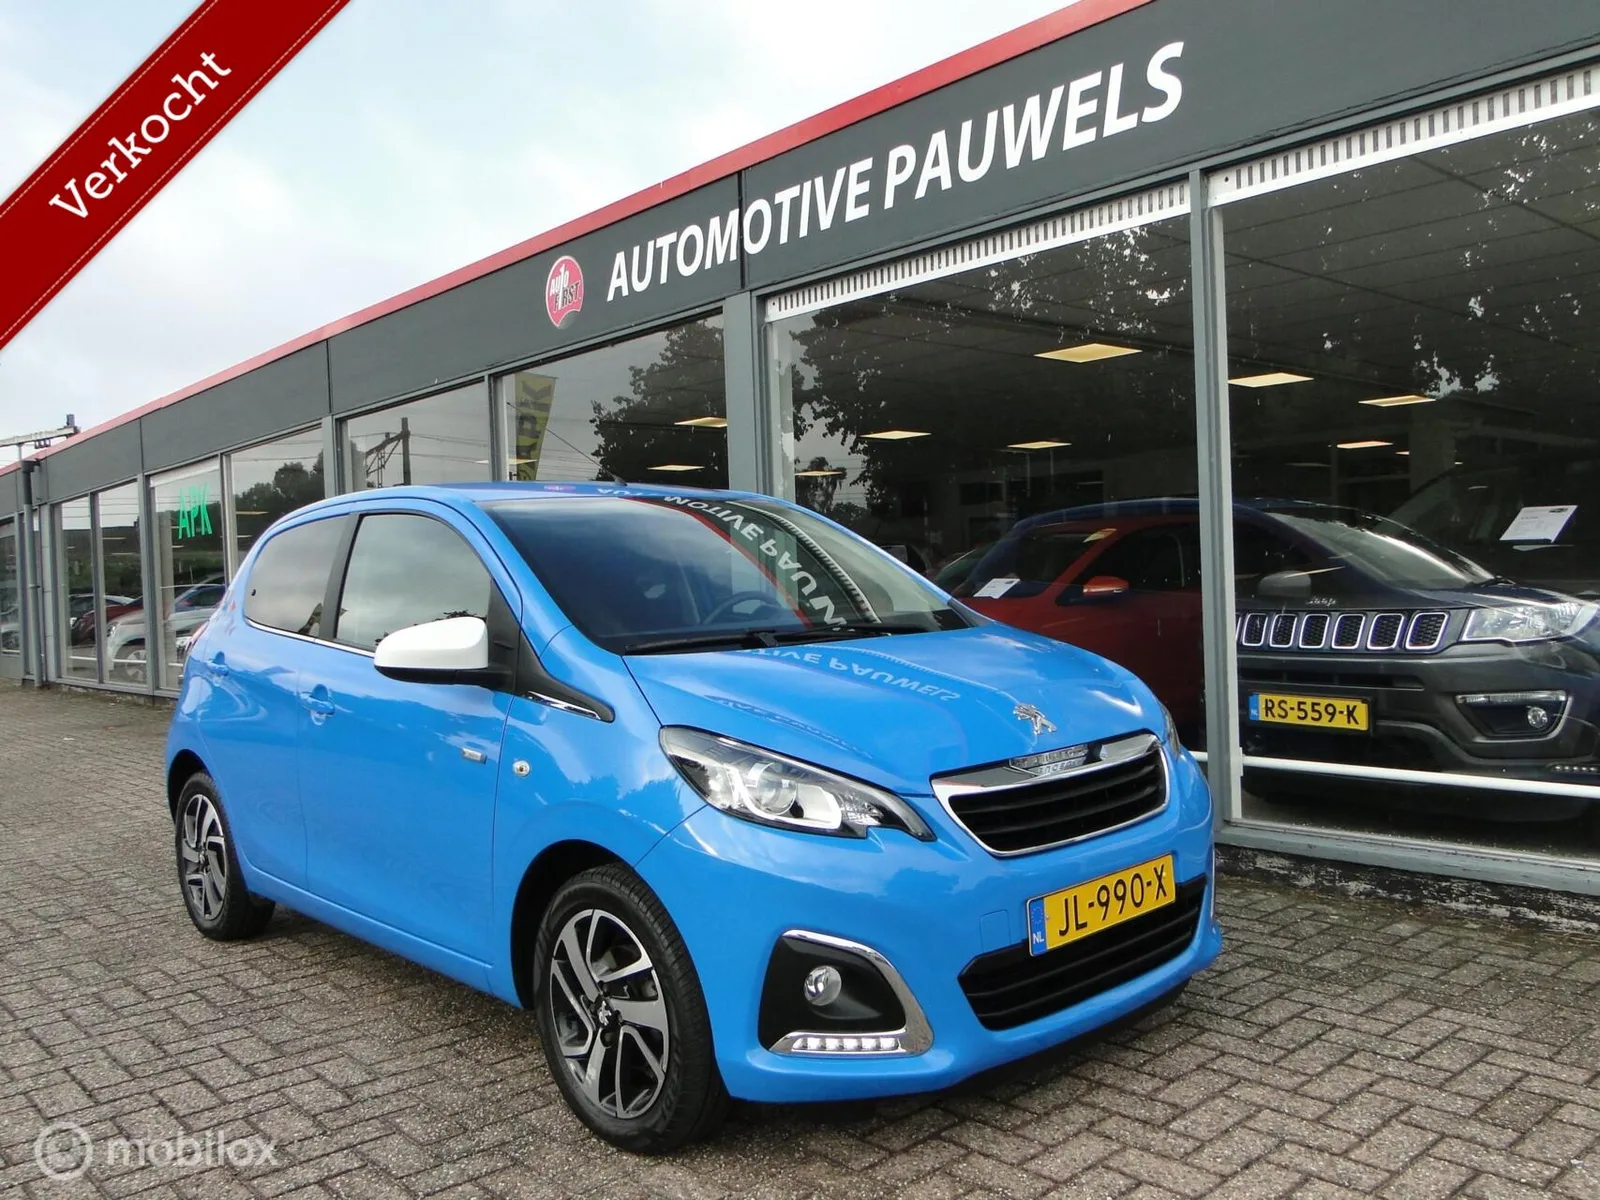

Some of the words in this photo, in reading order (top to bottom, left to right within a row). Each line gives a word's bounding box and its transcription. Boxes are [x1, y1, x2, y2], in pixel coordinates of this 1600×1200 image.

[607, 157, 874, 302] AUTOMOTIVE
[884, 41, 1184, 210] PAUWELS
[179, 483, 213, 540] APK
[1265, 698, 1359, 725] RS-559-K
[1032, 931, 1045, 945] NL
[1058, 864, 1168, 937] JL-990-X
